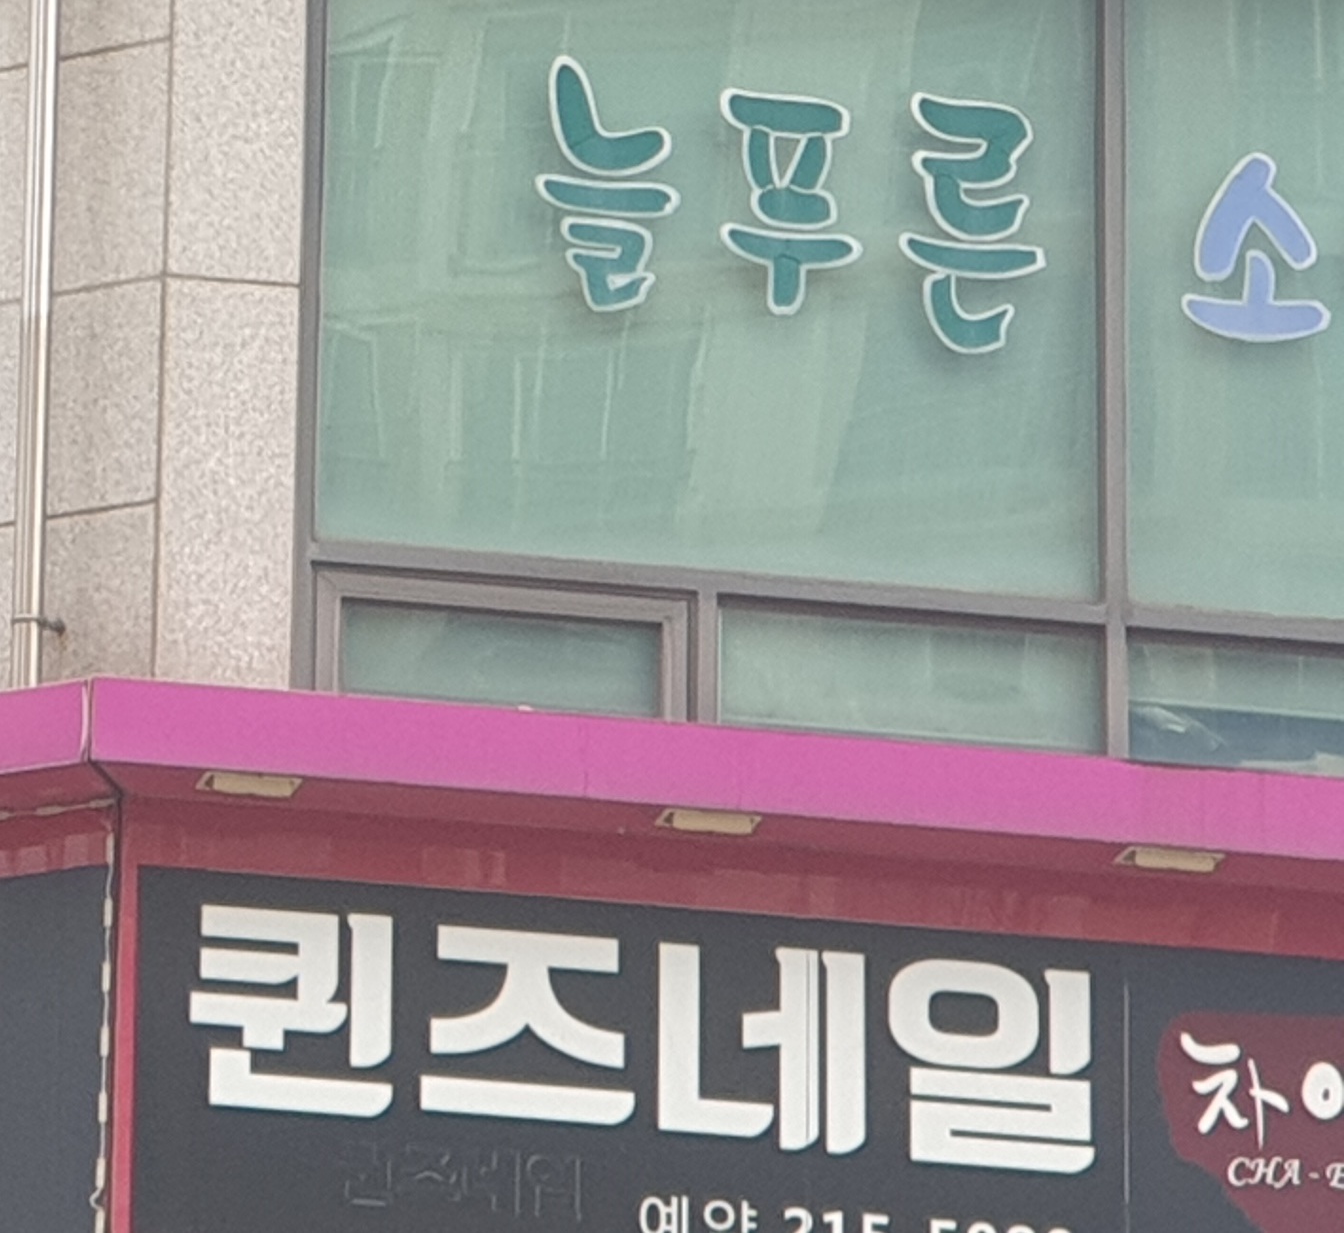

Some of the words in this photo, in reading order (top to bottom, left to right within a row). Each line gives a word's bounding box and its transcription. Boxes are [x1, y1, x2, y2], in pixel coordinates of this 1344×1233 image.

[536, 55, 1046, 354] 늘푸른
[1181, 153, 1330, 343] 소
[188, 903, 1097, 1176] 퀸즈네일
